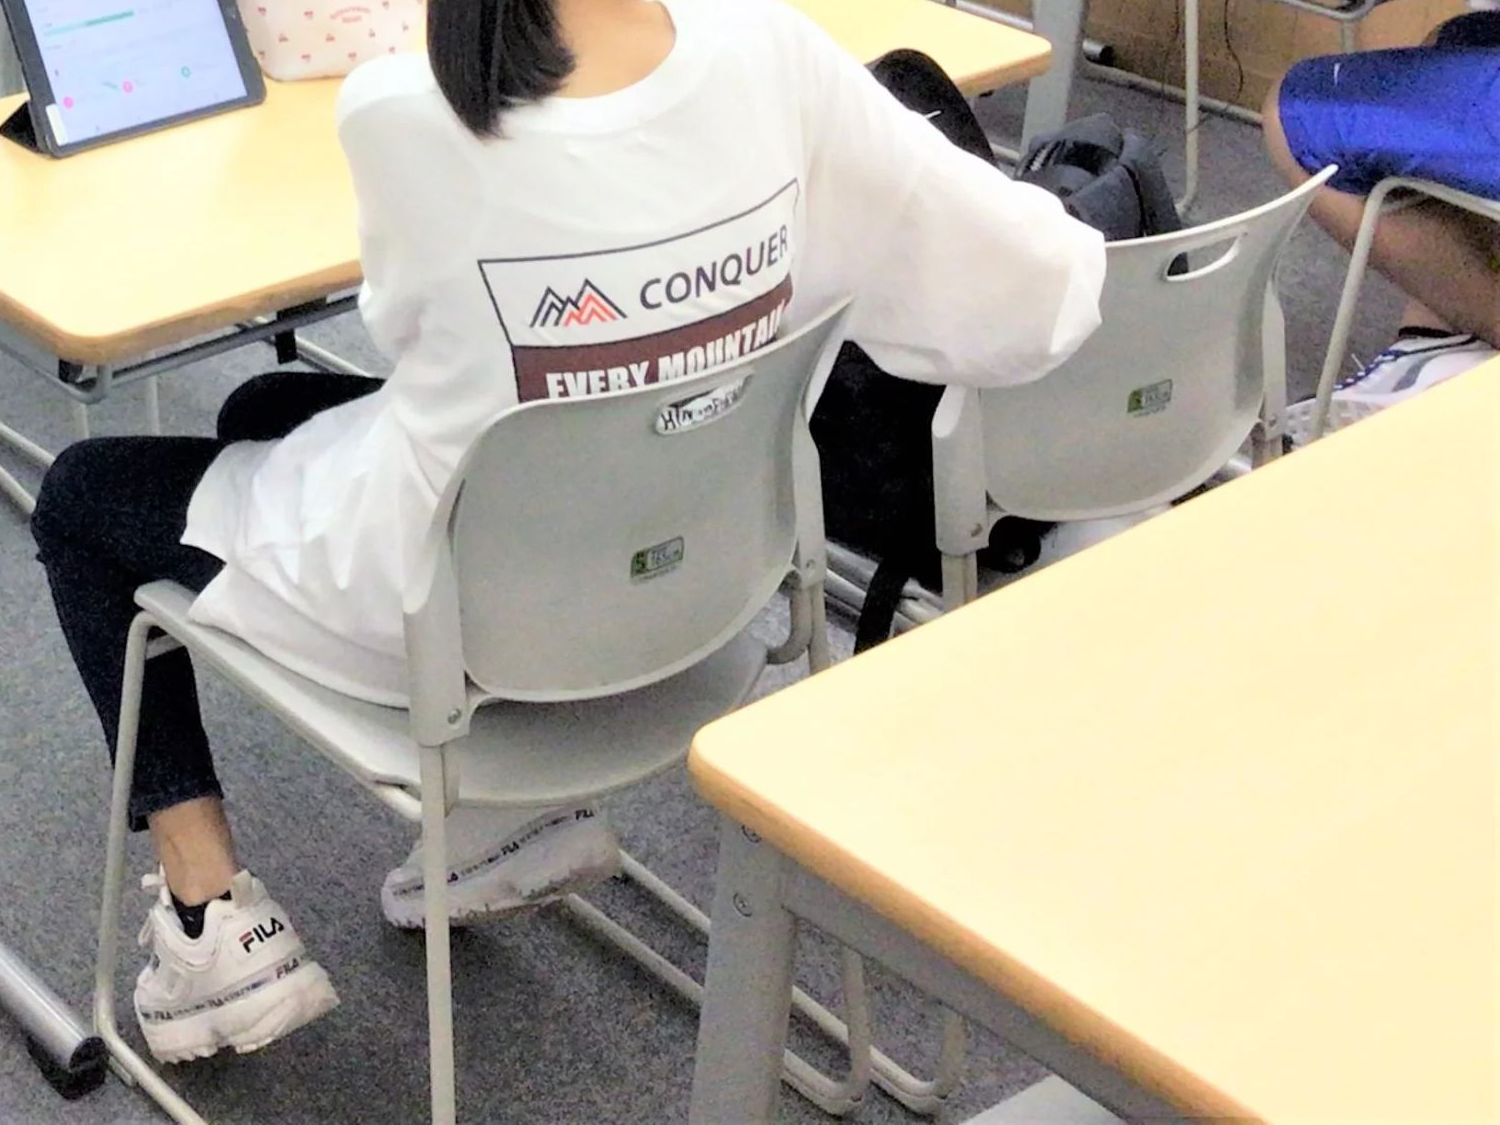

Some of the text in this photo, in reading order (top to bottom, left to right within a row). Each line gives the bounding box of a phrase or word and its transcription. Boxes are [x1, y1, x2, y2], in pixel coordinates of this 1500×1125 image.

[639, 224, 789, 310] CONQUER
[545, 360, 650, 399] EVERY
[238, 917, 285, 953] FILA
[276, 957, 300, 979] FILA
